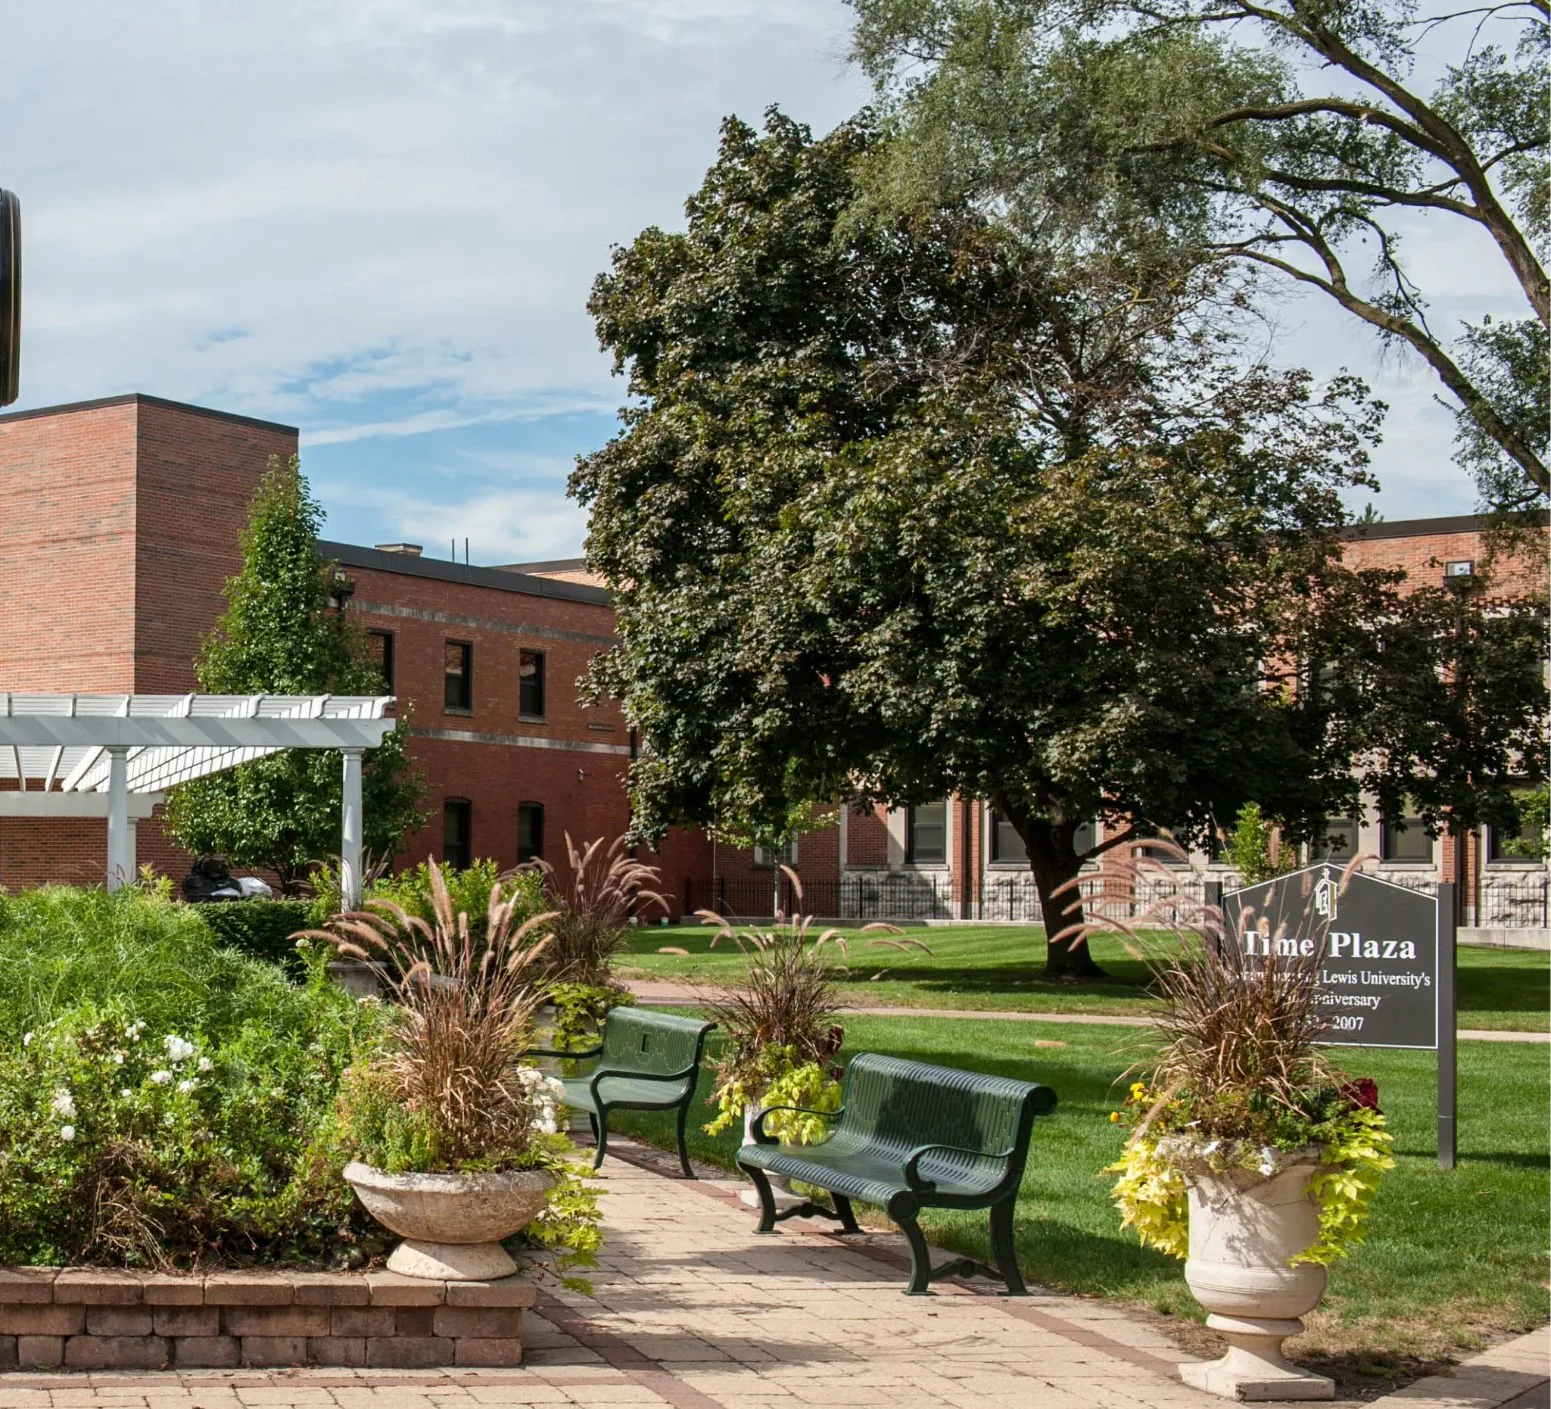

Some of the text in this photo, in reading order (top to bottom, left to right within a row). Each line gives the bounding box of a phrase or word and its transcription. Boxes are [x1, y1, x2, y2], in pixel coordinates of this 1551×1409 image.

[1243, 931, 1416, 958] Time Plaza
[1323, 970, 1358, 984] Lewis
[1361, 970, 1431, 989] University's
[1332, 1016, 1364, 1030] 2007
